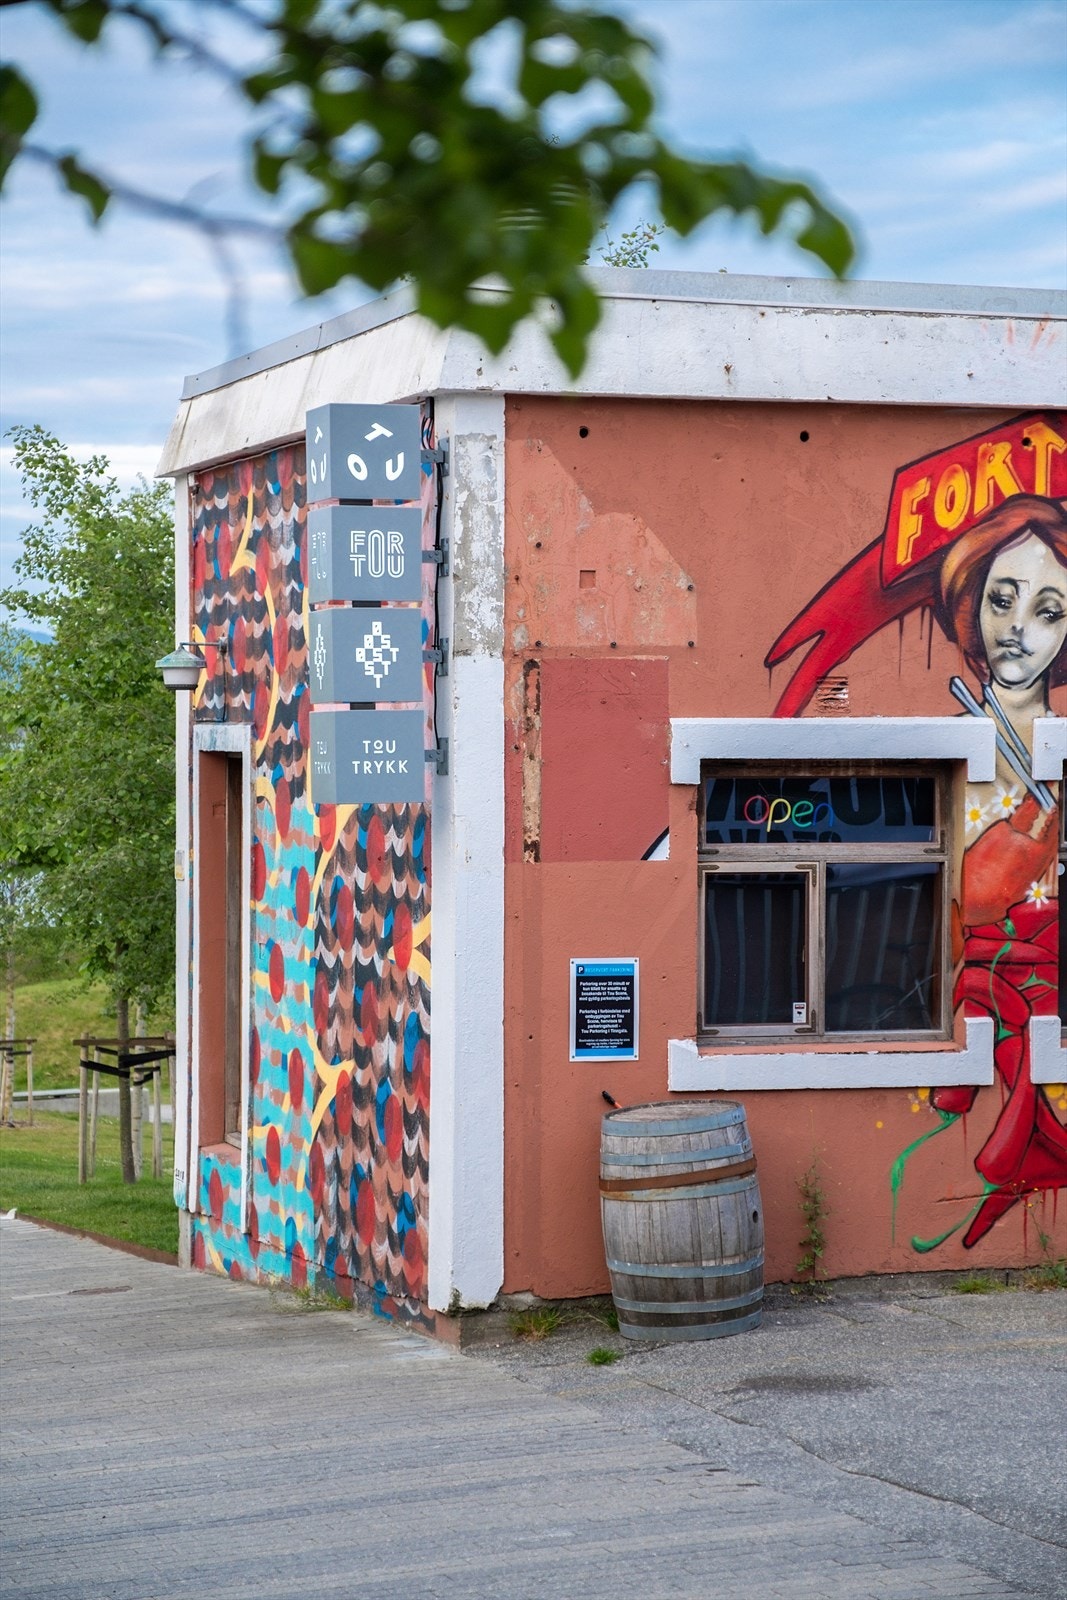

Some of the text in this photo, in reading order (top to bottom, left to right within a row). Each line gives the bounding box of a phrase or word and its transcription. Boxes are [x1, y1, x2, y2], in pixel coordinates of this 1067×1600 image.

[896, 421, 1067, 566] FORT
[362, 740, 396, 754] TOU
[352, 759, 408, 775] TRYKK
[743, 794, 835, 833] open
